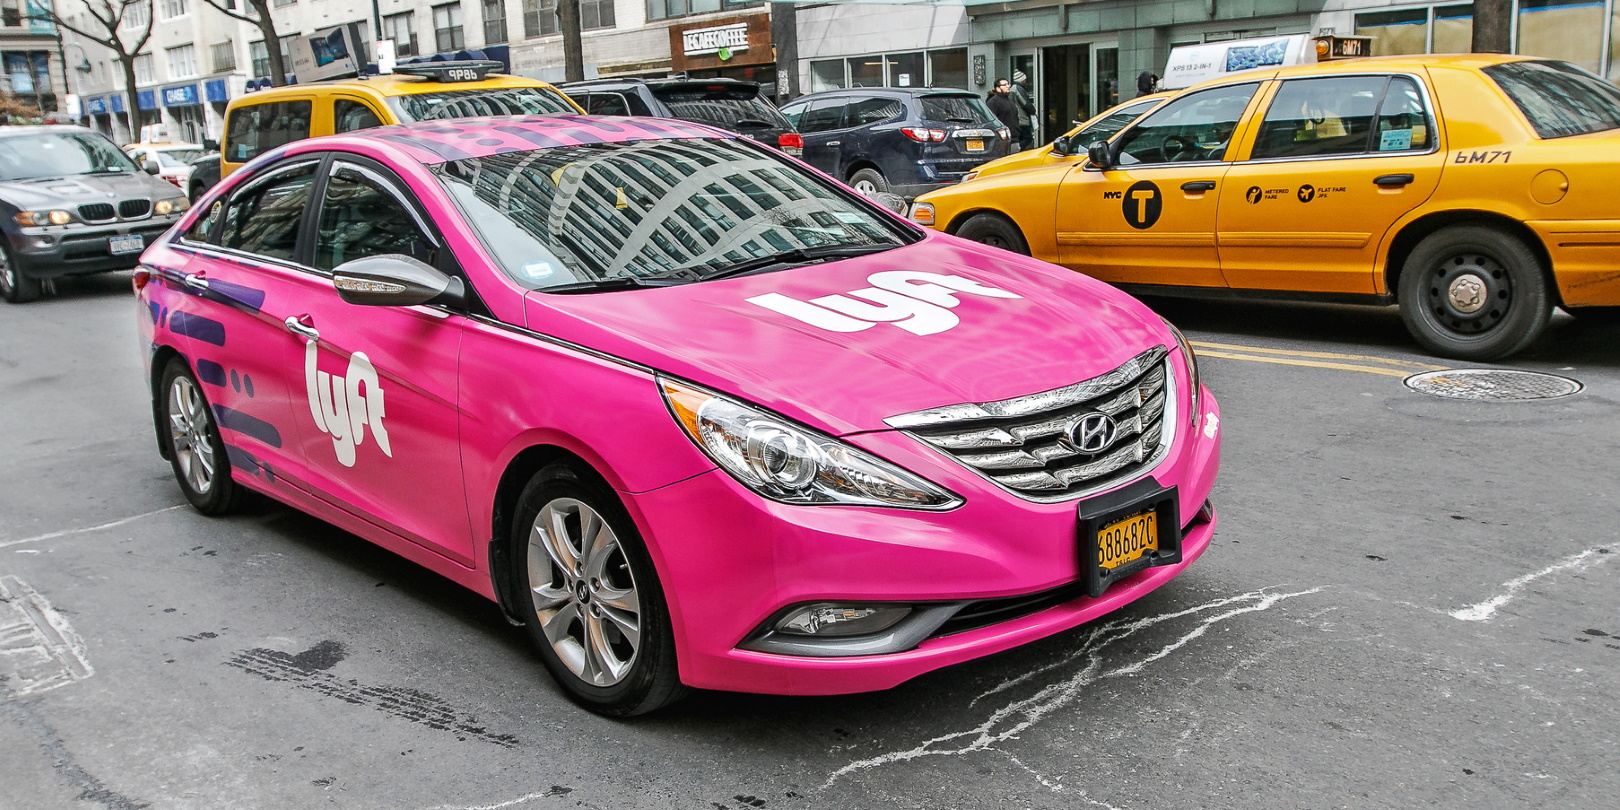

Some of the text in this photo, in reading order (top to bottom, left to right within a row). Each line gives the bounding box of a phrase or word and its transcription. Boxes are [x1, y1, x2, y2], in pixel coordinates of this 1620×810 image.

[1173, 64, 1185, 72] XPS
[1343, 40, 1361, 55] 6M71
[1103, 190, 1154, 223] NYC T
[744, 271, 1024, 336] lyft
[305, 339, 392, 467] lyft
[1098, 515, 1154, 565] 688682C
